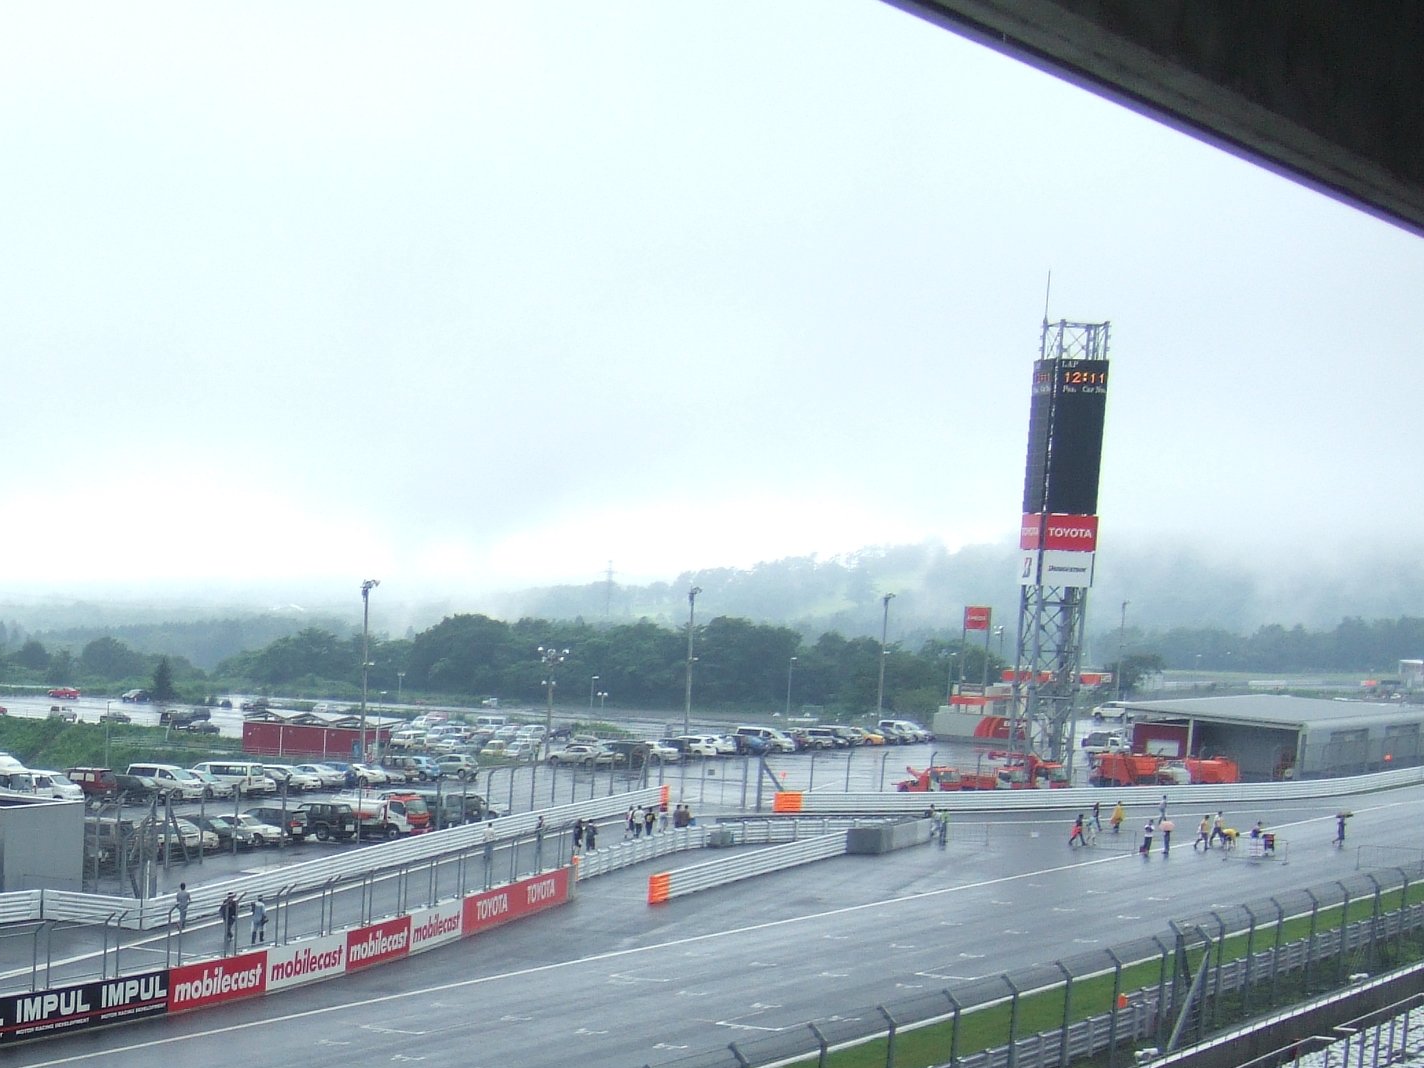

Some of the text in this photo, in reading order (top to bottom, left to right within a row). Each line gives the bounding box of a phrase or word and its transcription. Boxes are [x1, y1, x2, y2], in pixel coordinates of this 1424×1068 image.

[1065, 371, 1105, 384] 12:11
[1047, 526, 1092, 539] TOYOTA
[527, 878, 556, 904] TOYOTA
[475, 894, 508, 921] TOYOTA
[412, 911, 461, 943] mobilecast
[349, 925, 409, 963] mobilecast
[270, 944, 344, 982] mobilecast
[101, 975, 168, 1008] IMPUL
[174, 958, 264, 1003] mobilecast
[16, 989, 91, 1024] IMPUL
